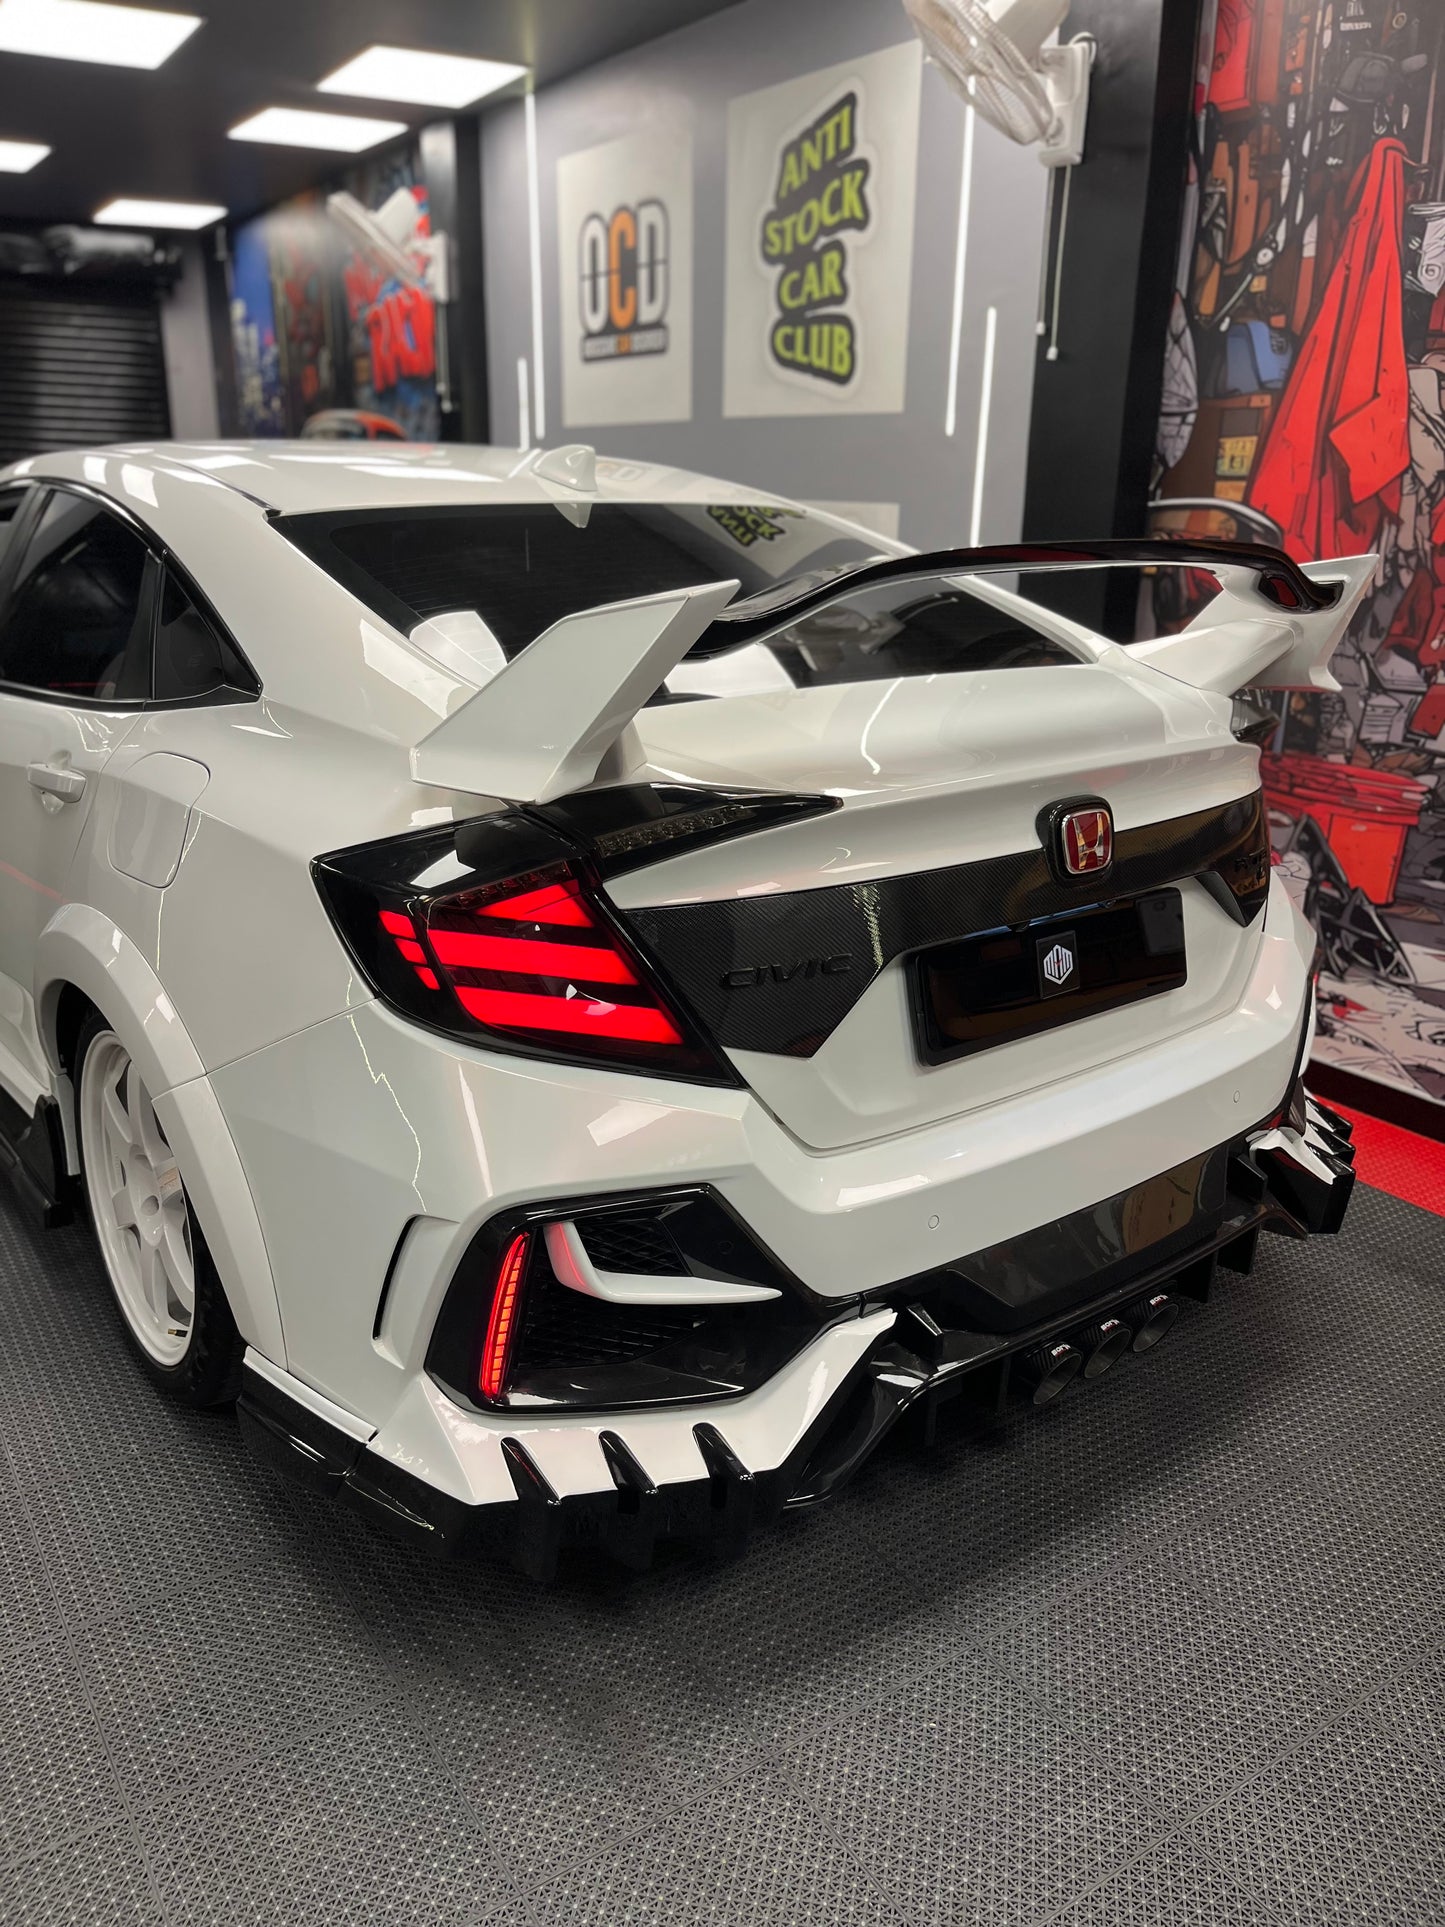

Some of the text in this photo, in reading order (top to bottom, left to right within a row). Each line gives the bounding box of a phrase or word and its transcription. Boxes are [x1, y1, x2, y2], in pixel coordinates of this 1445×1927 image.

[779, 105, 852, 197] ANTI
[765, 169, 864, 255] STOCK
[580, 198, 668, 333] OCD
[779, 250, 843, 308] CAR
[774, 323, 852, 375] CLUB
[720, 953, 852, 988] CIVIC
